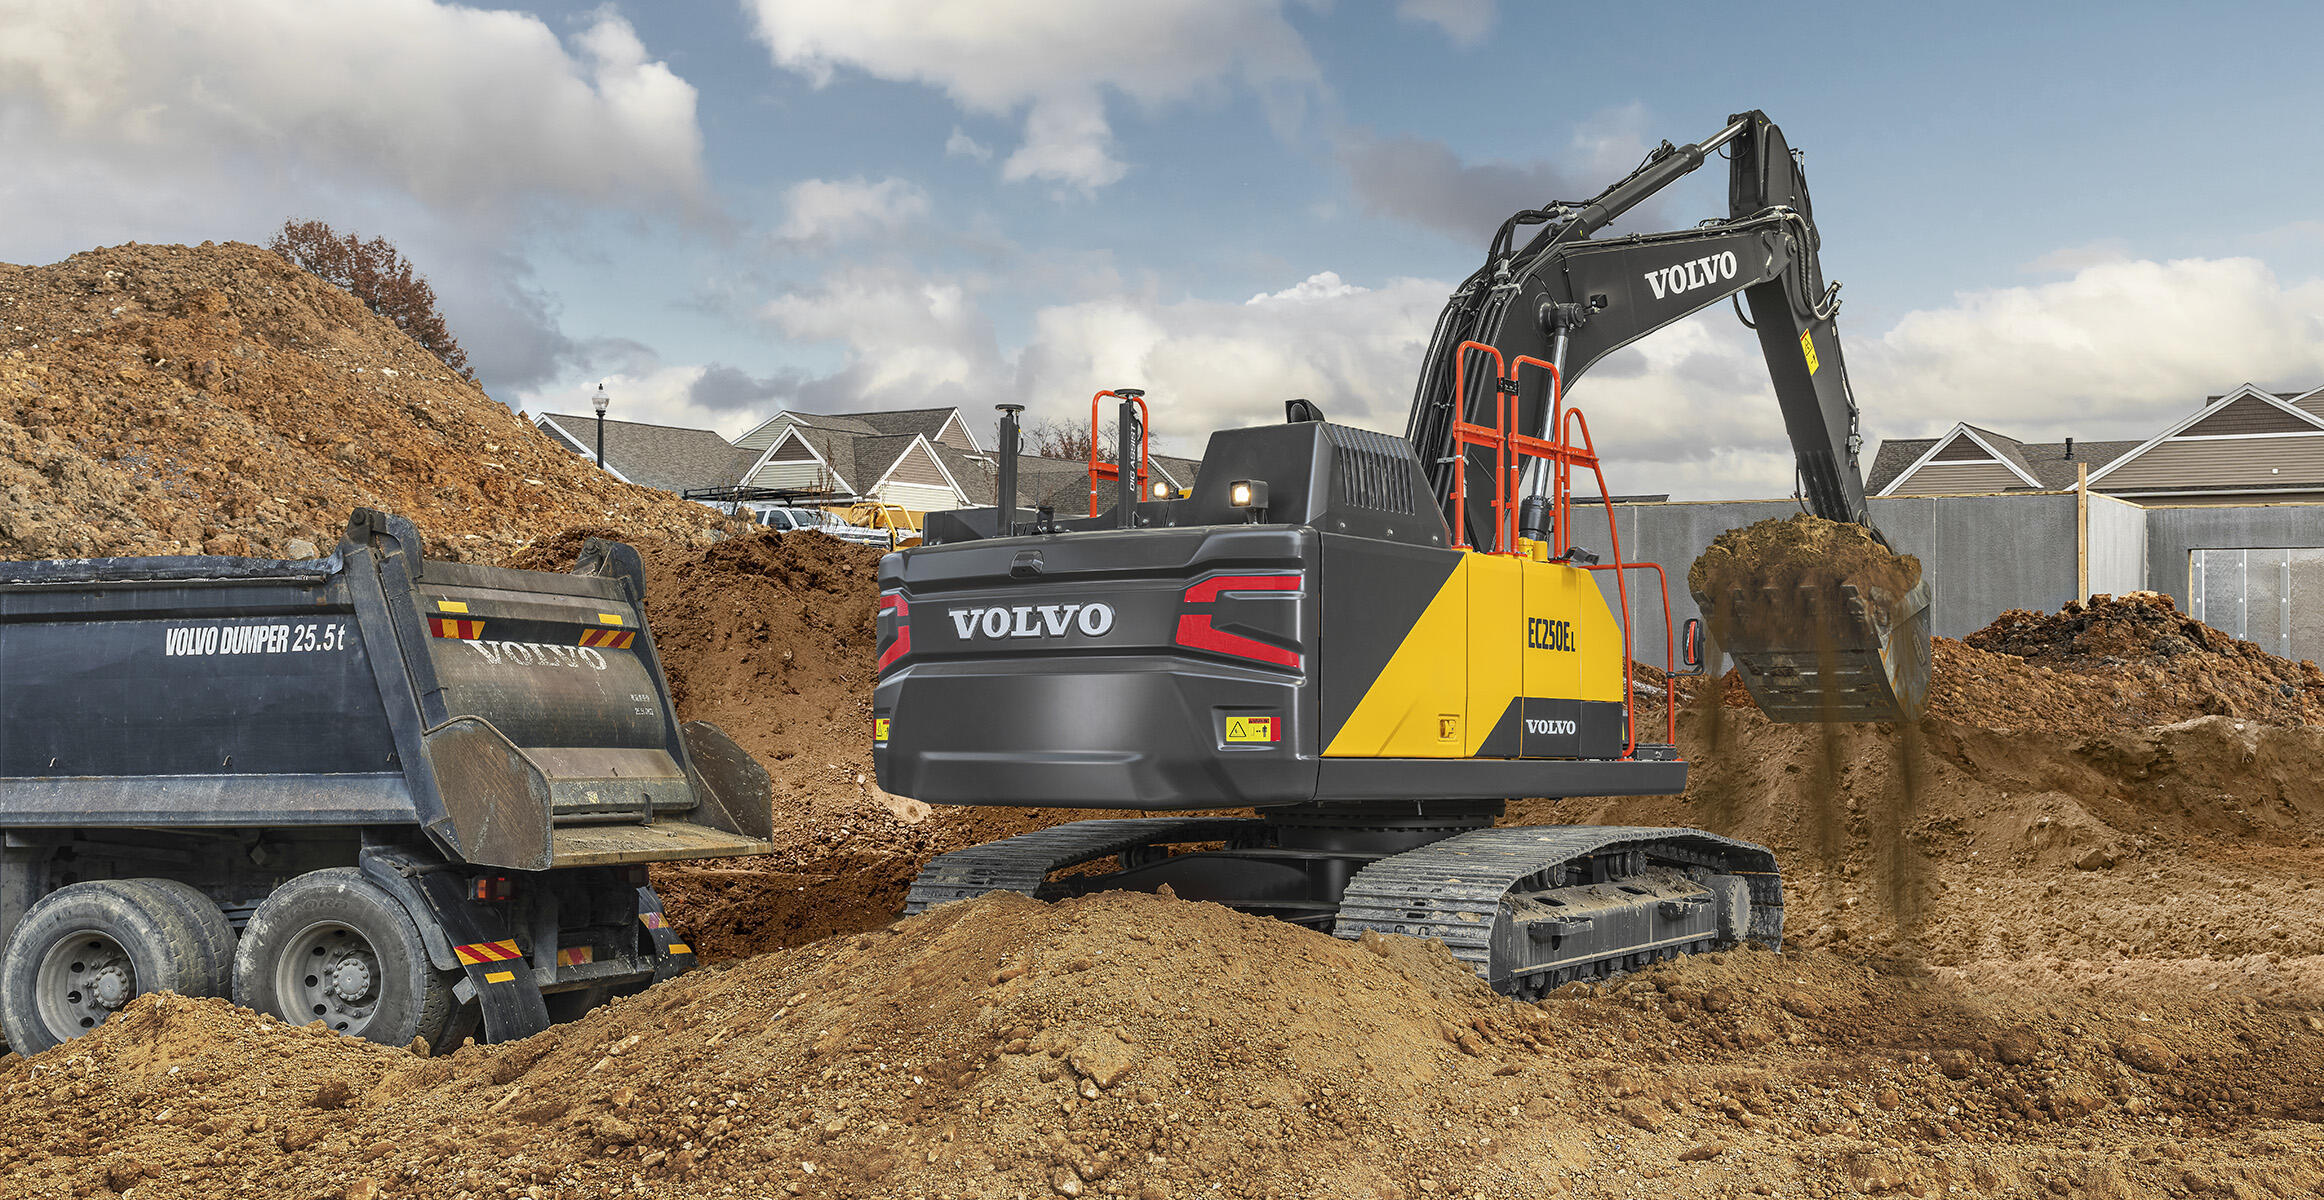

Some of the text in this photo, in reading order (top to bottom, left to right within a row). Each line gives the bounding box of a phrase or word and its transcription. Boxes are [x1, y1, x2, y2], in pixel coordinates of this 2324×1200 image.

[1644, 250, 1737, 300] VOLVO
[949, 603, 1113, 639] VOLVO
[165, 626, 219, 656] VOLVO
[219, 624, 290, 655] DUMPER
[462, 639, 608, 671] VOLVO
[1525, 719, 1576, 735] VOLVO
